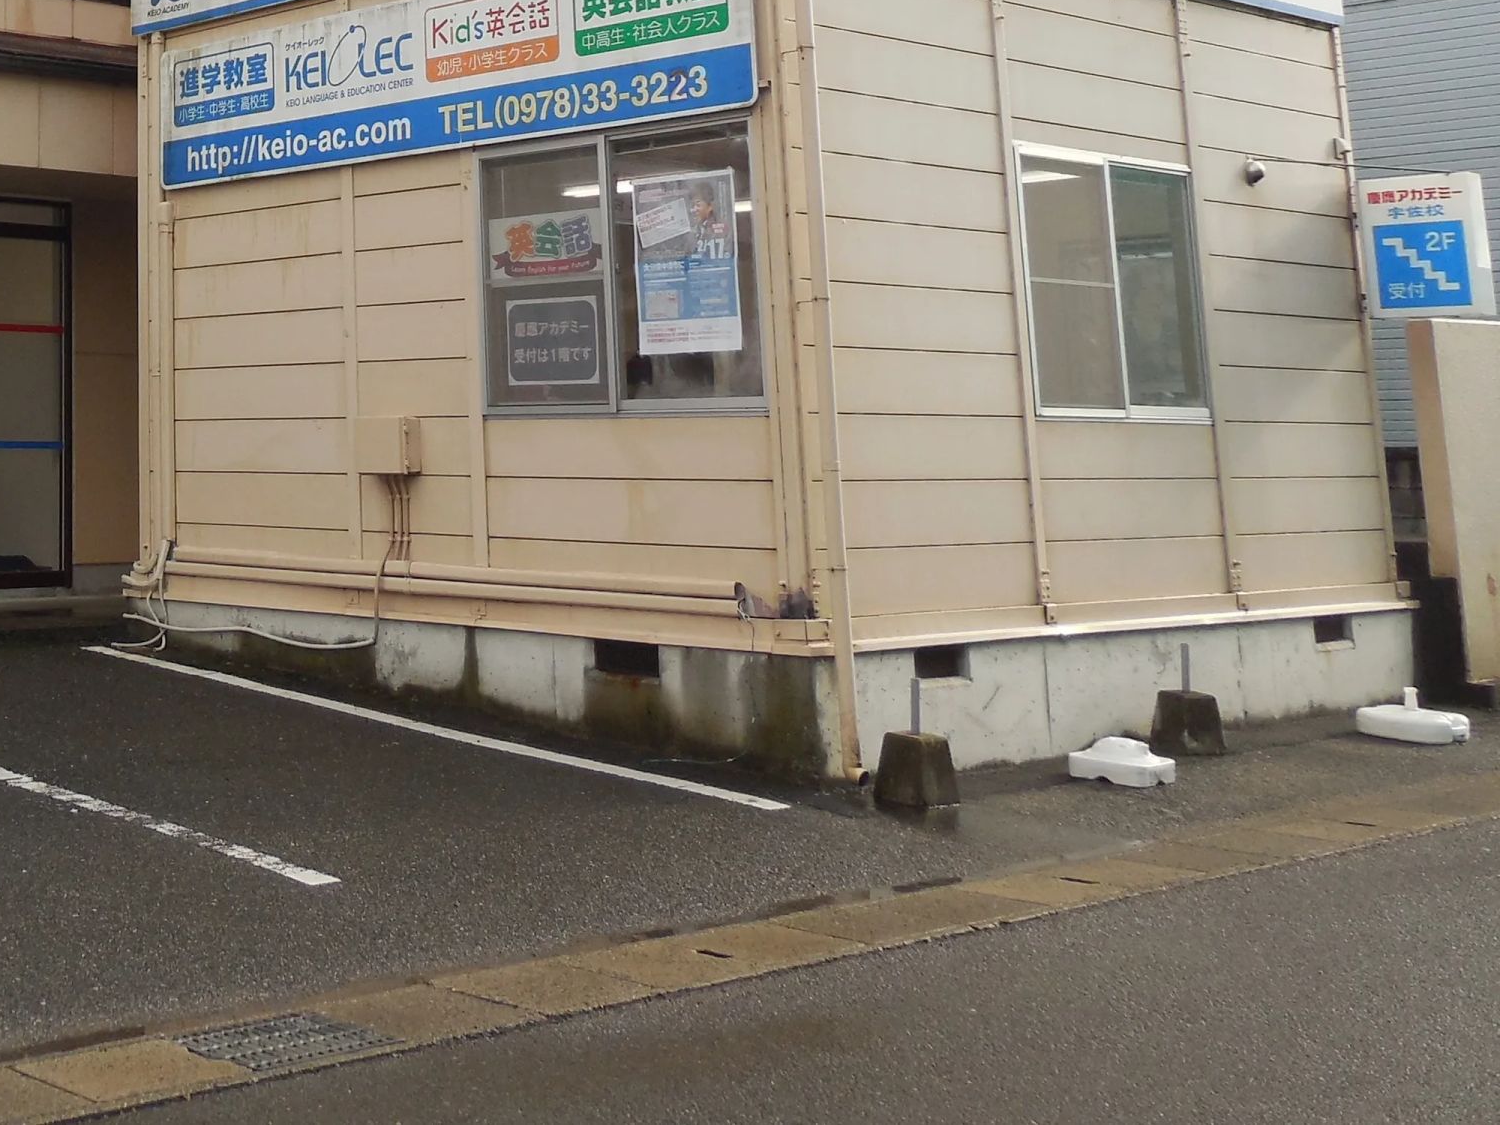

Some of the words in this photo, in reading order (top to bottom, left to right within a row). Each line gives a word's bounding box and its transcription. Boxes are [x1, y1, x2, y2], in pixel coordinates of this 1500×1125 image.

[162, 1, 190, 14] ACADEMY
[179, 52, 268, 99] 進学教室
[285, 98, 301, 107] KEIO
[302, 91, 338, 105] LANGUAGE
[340, 89, 346, 98] &
[347, 83, 386, 98] EDUCATION
[387, 78, 414, 90] CENTER
[187, 116, 412, 174] http://keio-ac.com
[1388, 205, 1444, 219] 宇佐校
[505, 213, 592, 262] 英会話
[1425, 231, 1456, 251] 2F
[1388, 282, 1426, 299] 受付
